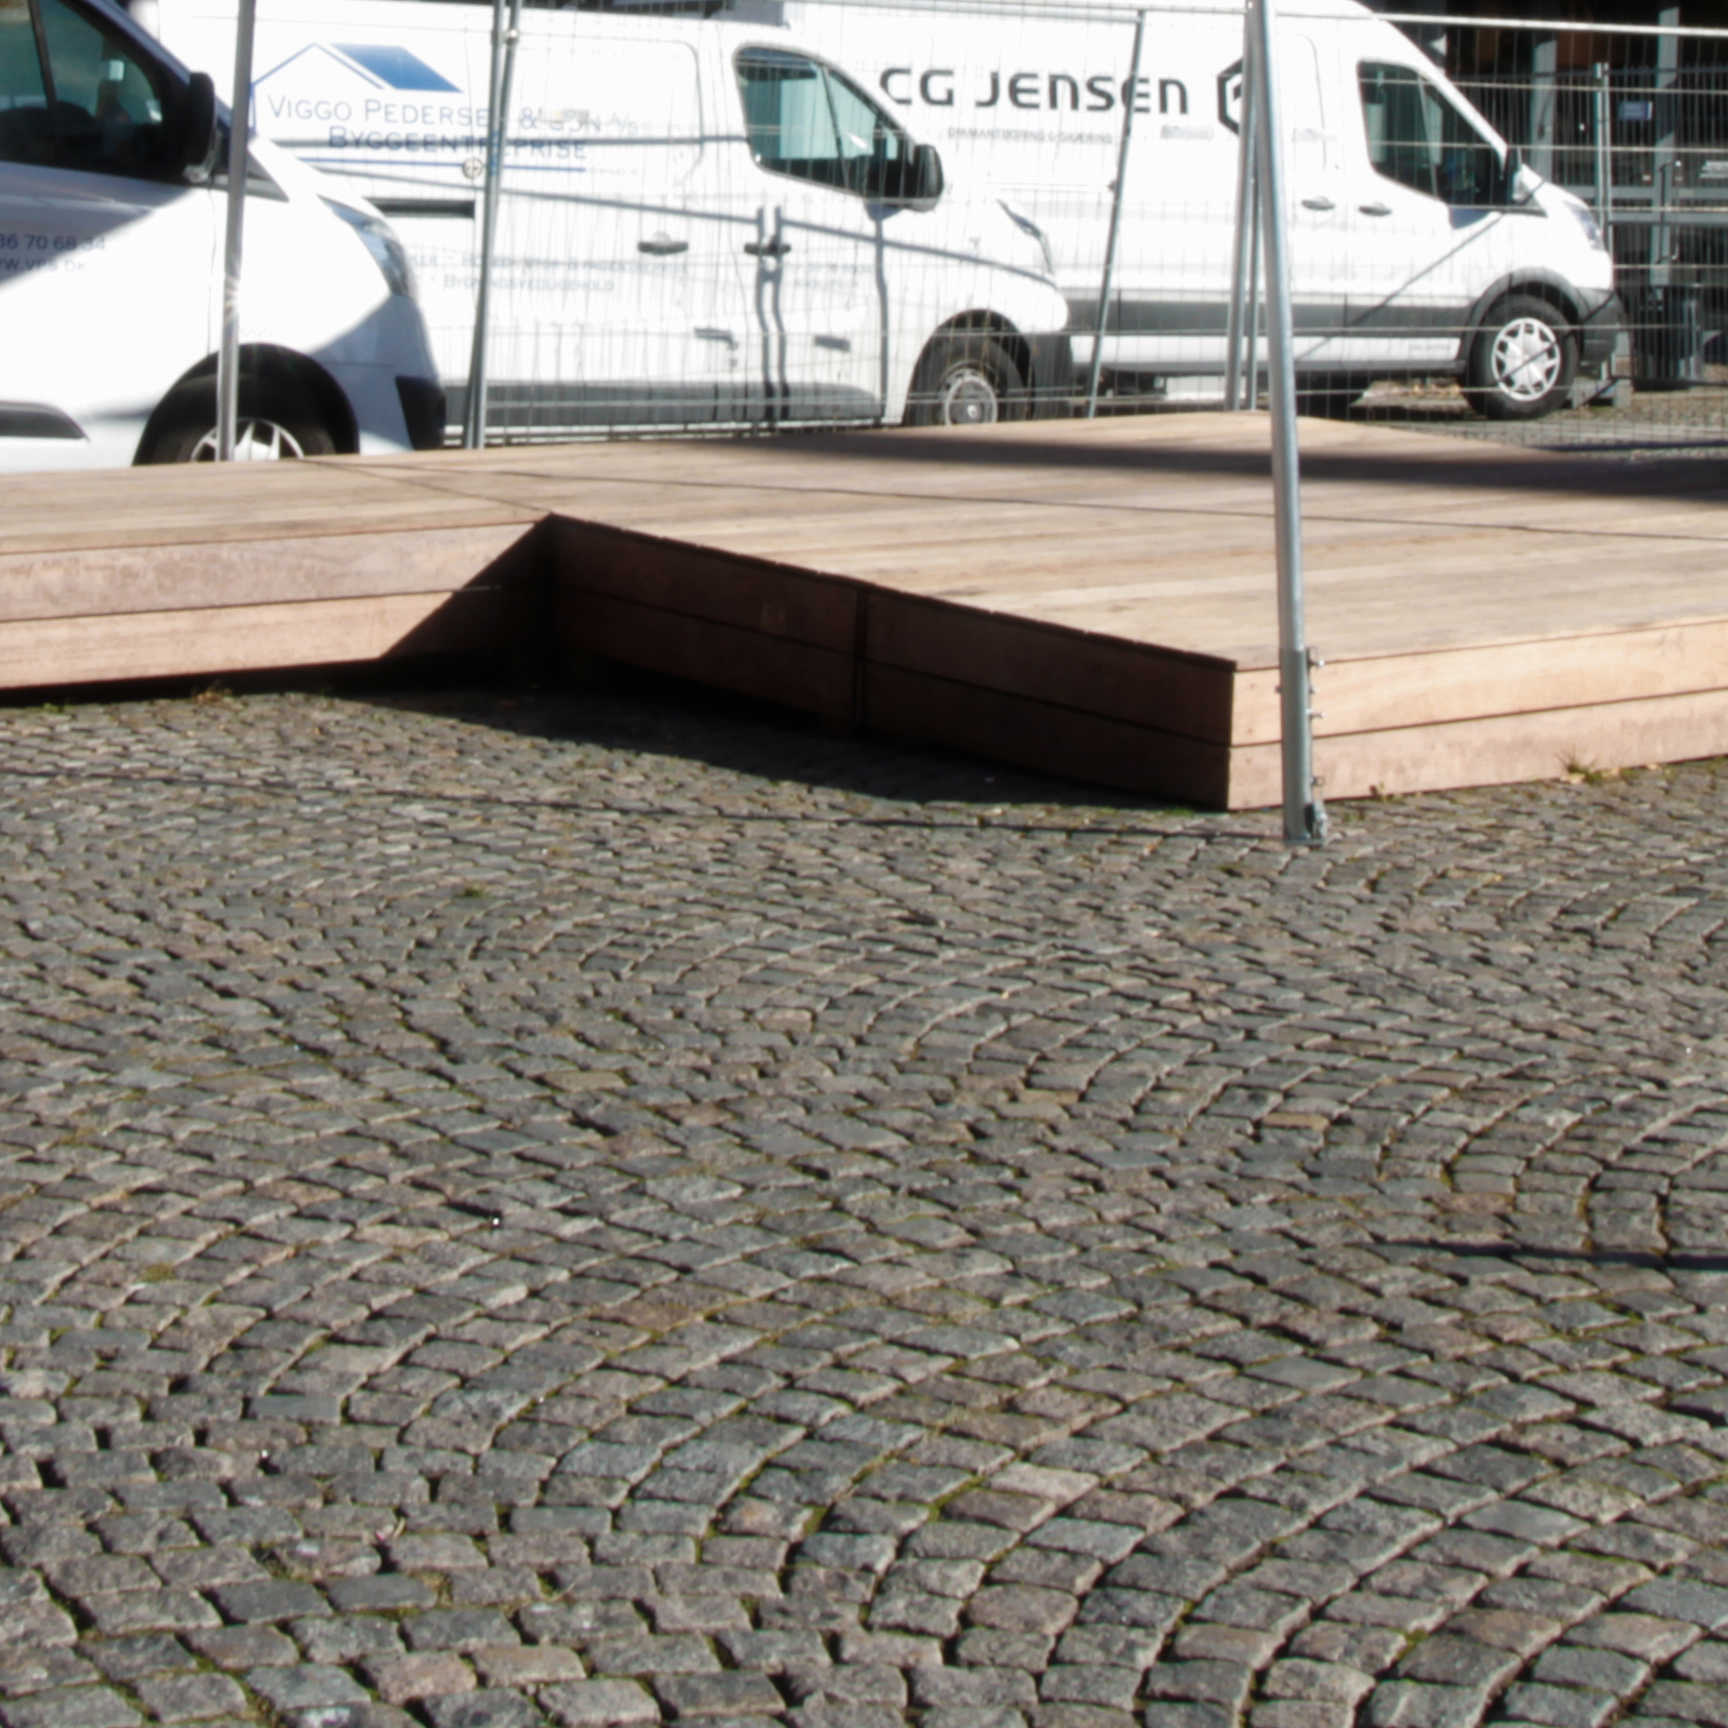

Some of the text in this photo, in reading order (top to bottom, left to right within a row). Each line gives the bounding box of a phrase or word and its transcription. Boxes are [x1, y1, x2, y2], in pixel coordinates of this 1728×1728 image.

[879, 66, 955, 108] CG
[267, 94, 353, 121] VIGGO
[363, 98, 491, 128] PEDERSE
